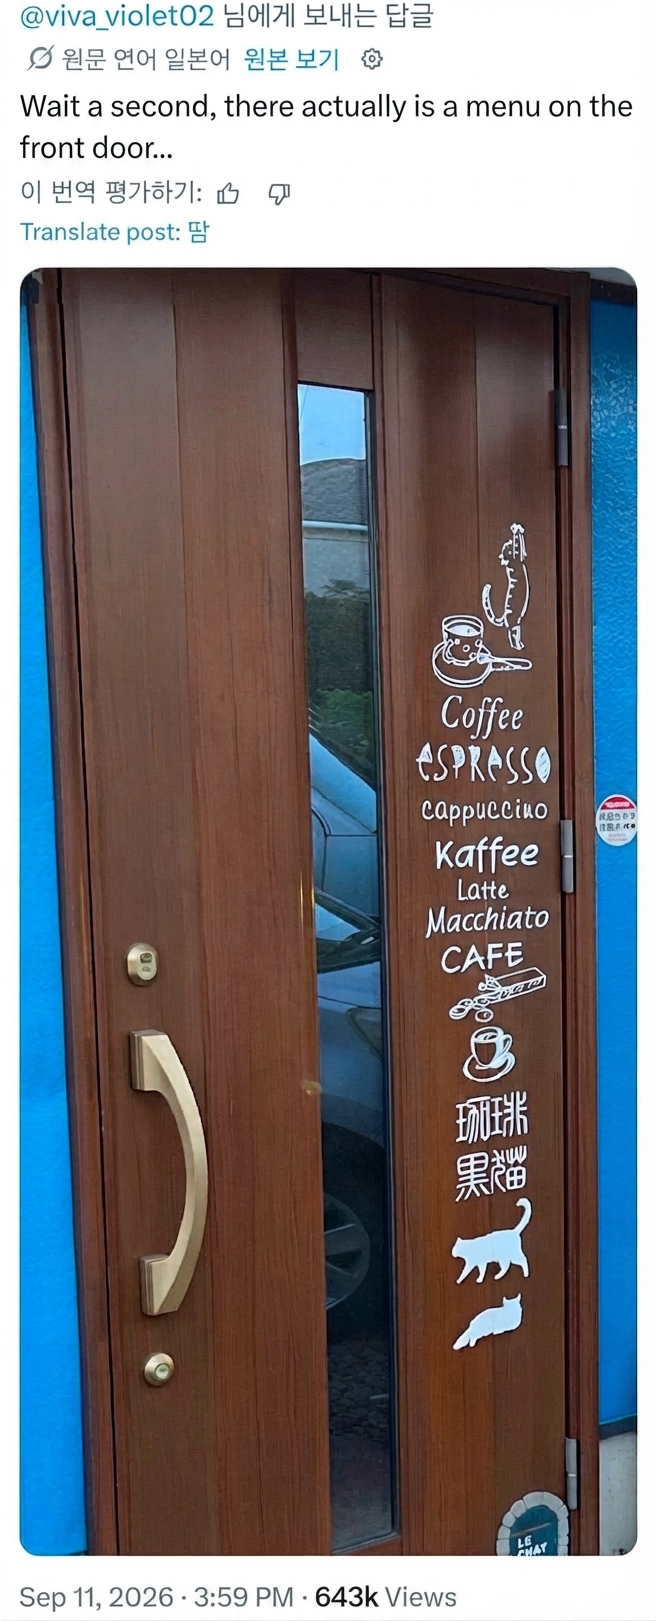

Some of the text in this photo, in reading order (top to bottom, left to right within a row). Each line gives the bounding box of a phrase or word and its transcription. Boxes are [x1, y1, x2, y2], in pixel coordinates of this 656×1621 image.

[441, 695, 523, 739] Coffee
[436, 836, 539, 873] Kaffee
[458, 878, 509, 901] Latte
[426, 906, 549, 939] Macchiato
[441, 942, 524, 973] CAFE
[456, 1091, 528, 1144] 珈琲
[455, 1145, 527, 1202] 黒猫
[518, 1535, 532, 1549] LE
